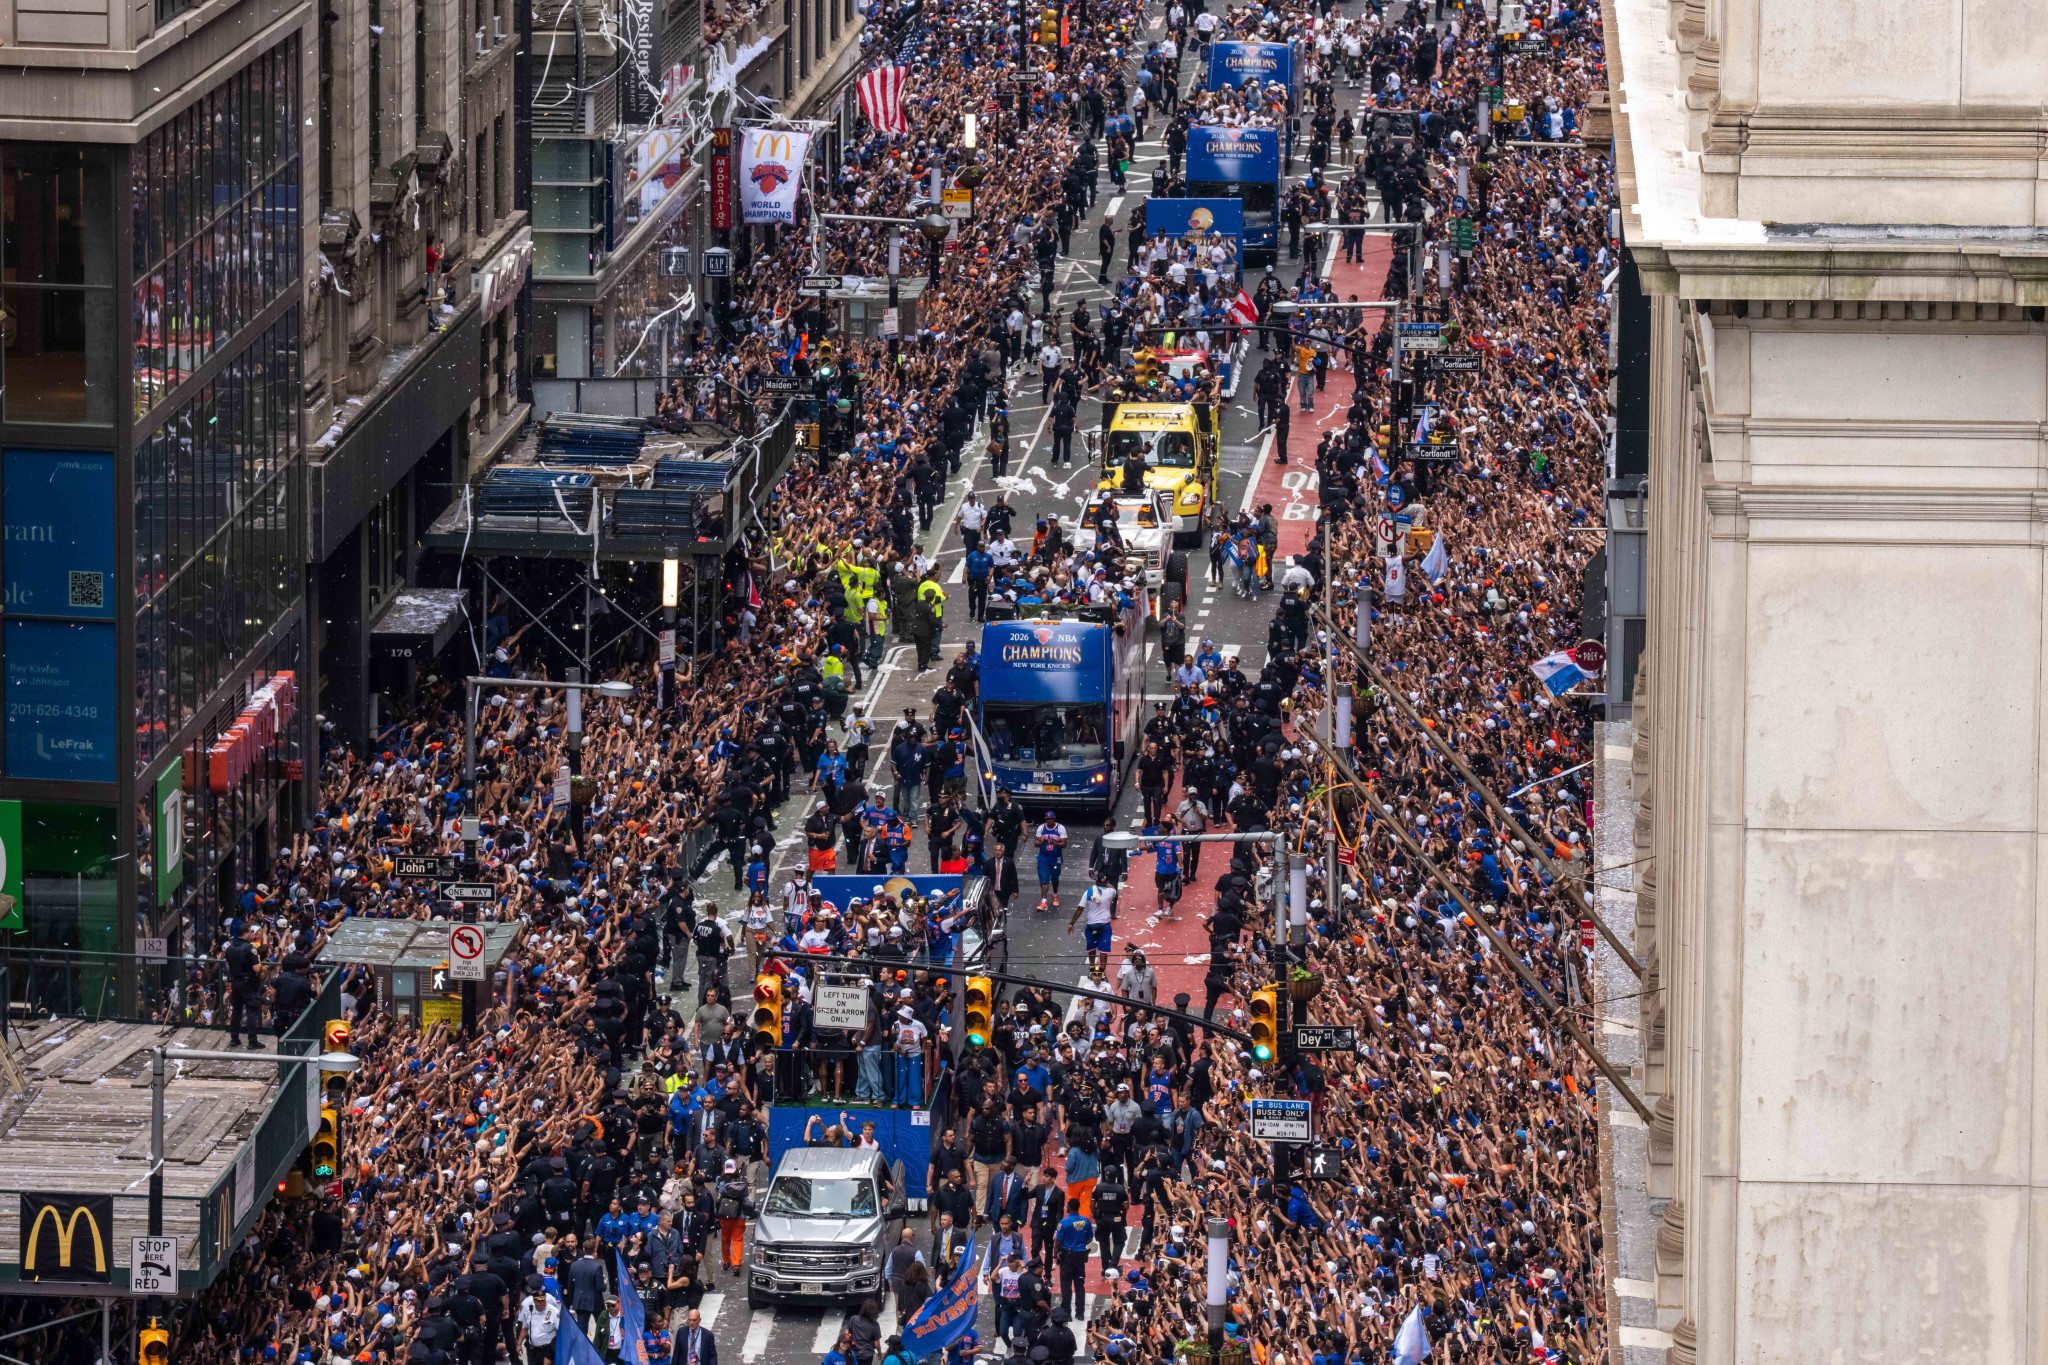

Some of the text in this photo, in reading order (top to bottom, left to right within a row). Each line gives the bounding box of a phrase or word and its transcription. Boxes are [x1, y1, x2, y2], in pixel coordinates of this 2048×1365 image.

[1520, 44, 1540, 52] Liberty
[638, 1, 654, 113] Residence INN
[630, 60, 636, 70] BY
[1225, 56, 1278, 70] CHAMPIONS
[1206, 141, 1262, 154] CHAMPIONS
[751, 201, 781, 209] WORLD
[709, 257, 724, 269] GAP
[1444, 361, 1472, 369] Cortlandt
[766, 381, 792, 389] Maiden
[1420, 449, 1451, 459] Cortlandt
[1391, 570, 1397, 580] 8
[1010, 632, 1078, 642] 2026 NBA
[390, 648, 413, 658] 176
[1002, 644, 1082, 664] CHAMPIONS
[1583, 651, 1598, 661] PRET
[10, 663, 59, 674] Ray Kawas
[30, 676, 69, 687] Johnson
[10, 703, 98, 719] 201-626-4348
[50, 738, 94, 750] LeFrak
[399, 861, 426, 873] John
[448, 888, 465, 896] ONE
[796, 892, 805, 905] 11
[697, 925, 712, 935] NYPD
[143, 939, 162, 952] 182
[823, 991, 860, 1000] LEFT TURN
[816, 1006, 865, 1016] GREEN ARROW
[830, 1015, 850, 1023] ONLY
[783, 1022, 790, 1034] 3
[1300, 1033, 1321, 1046] Dey
[1154, 1091, 1161, 1102] 7
[138, 1240, 171, 1252] STOP
[144, 1253, 165, 1261] HERE
[140, 1269, 152, 1277] ON
[134, 1278, 159, 1290] RED
